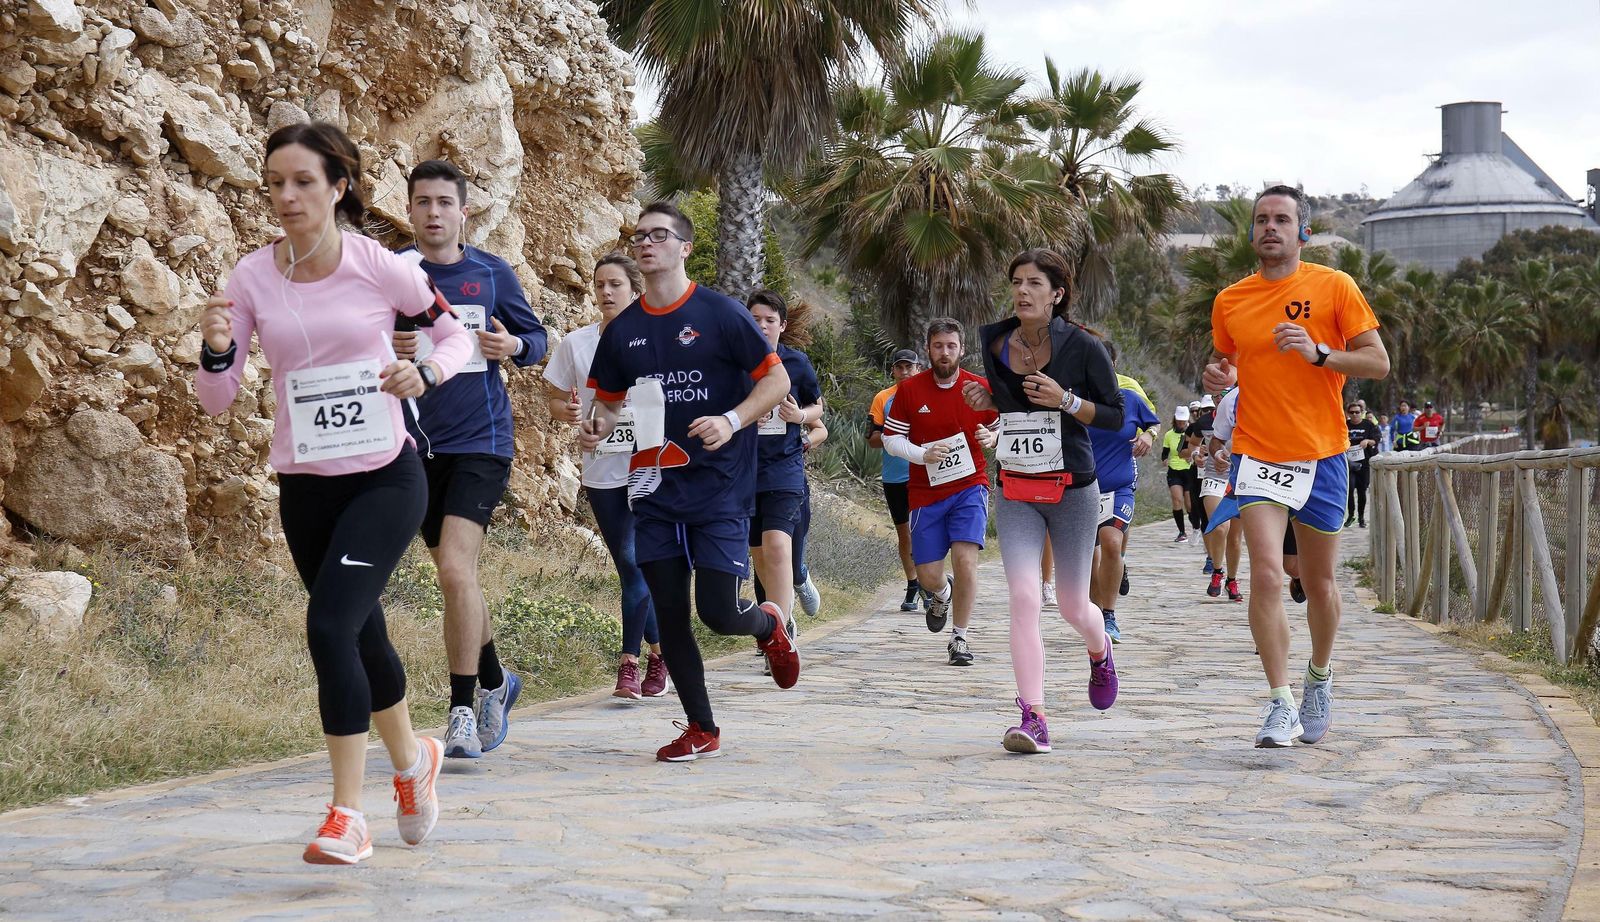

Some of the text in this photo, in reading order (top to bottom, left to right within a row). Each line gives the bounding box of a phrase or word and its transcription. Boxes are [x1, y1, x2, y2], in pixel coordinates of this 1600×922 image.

[314, 401, 365, 430] 452
[1010, 437, 1044, 455] 416
[1257, 466, 1295, 488] 342
